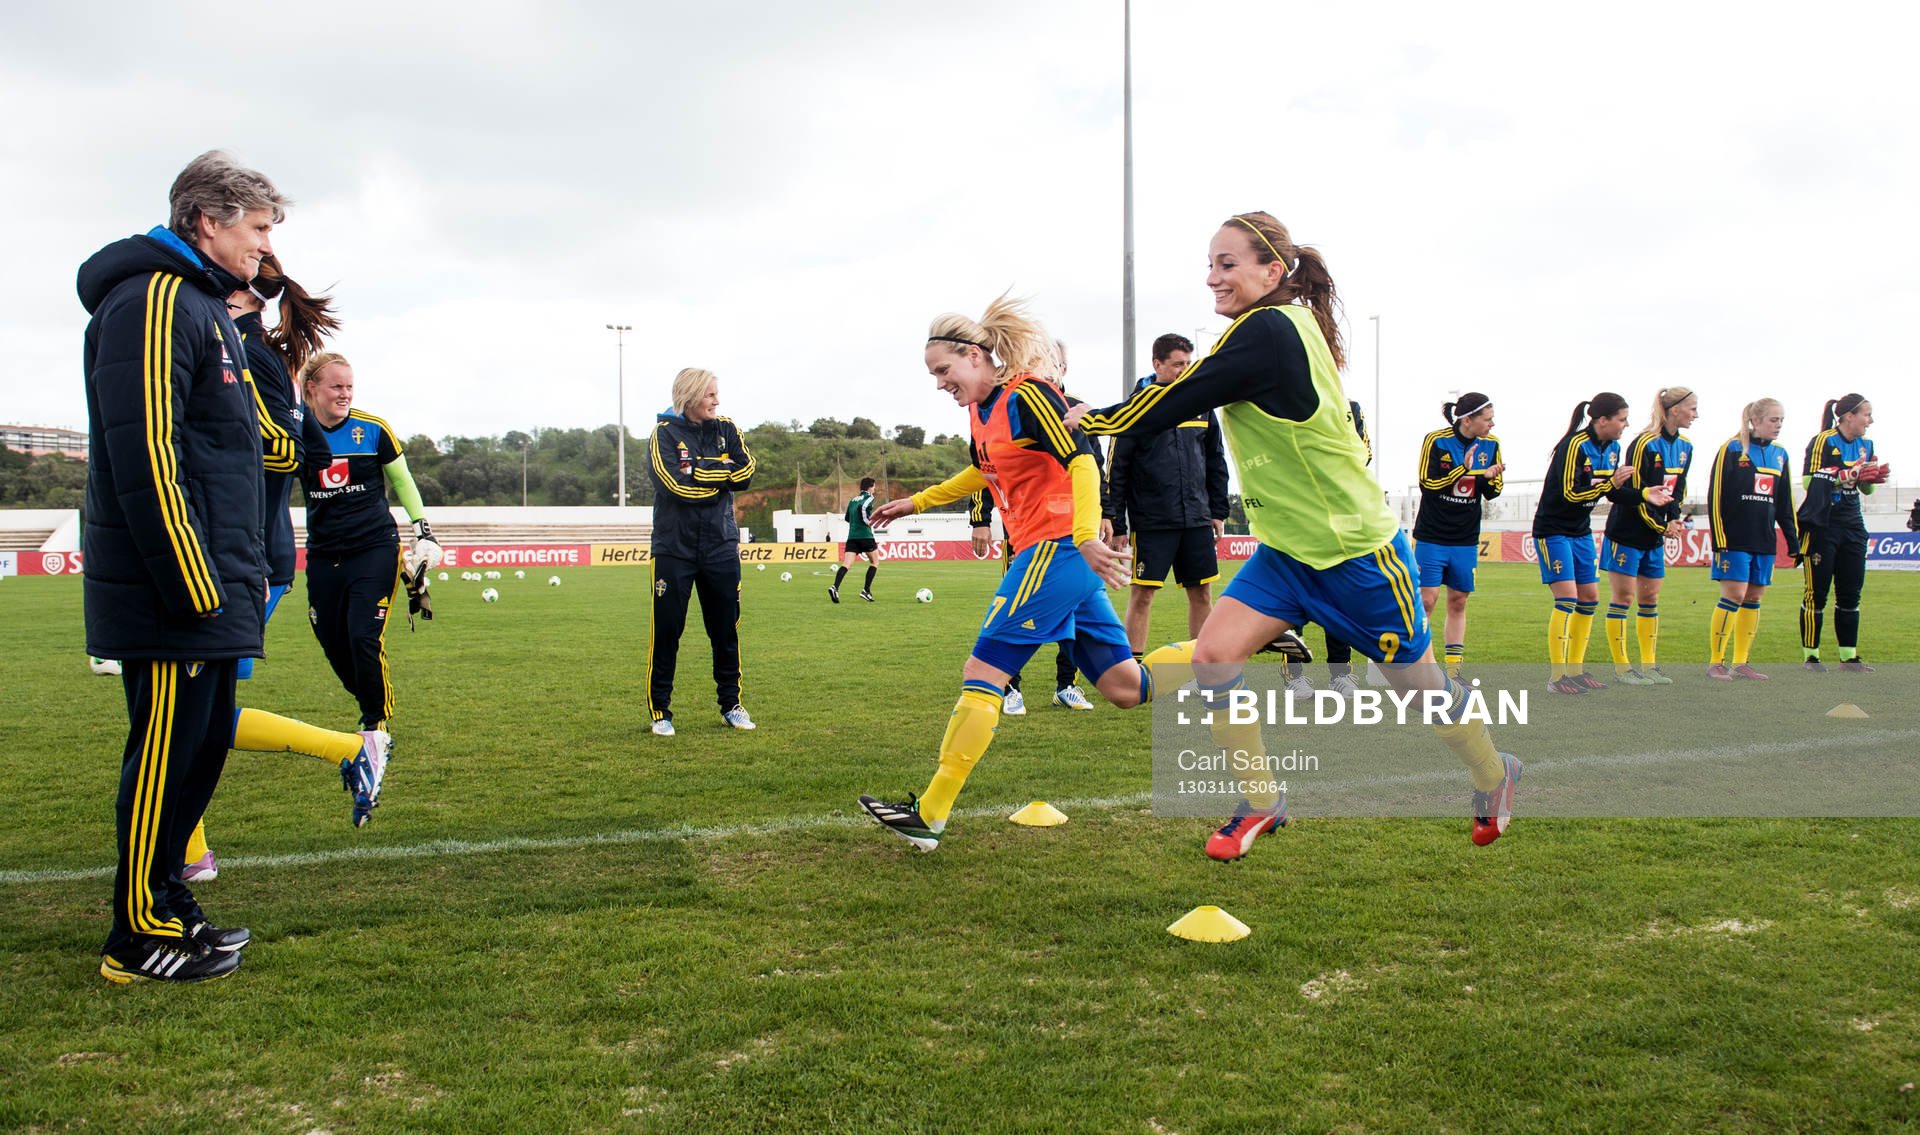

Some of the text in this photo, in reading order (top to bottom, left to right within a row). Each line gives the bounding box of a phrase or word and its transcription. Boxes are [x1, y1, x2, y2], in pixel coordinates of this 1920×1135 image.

[309, 484, 366, 499] SVENSKA SPEL
[1741, 494, 1768, 502] SVENSKA
[784, 546, 827, 560] Hertz
[878, 541, 936, 560] SAGRES
[1878, 537, 1920, 555] Garv
[471, 549, 578, 564] CONTINENTE
[602, 548, 648, 562] Hertz
[984, 595, 1007, 629] 7
[1379, 632, 1400, 664] 9
